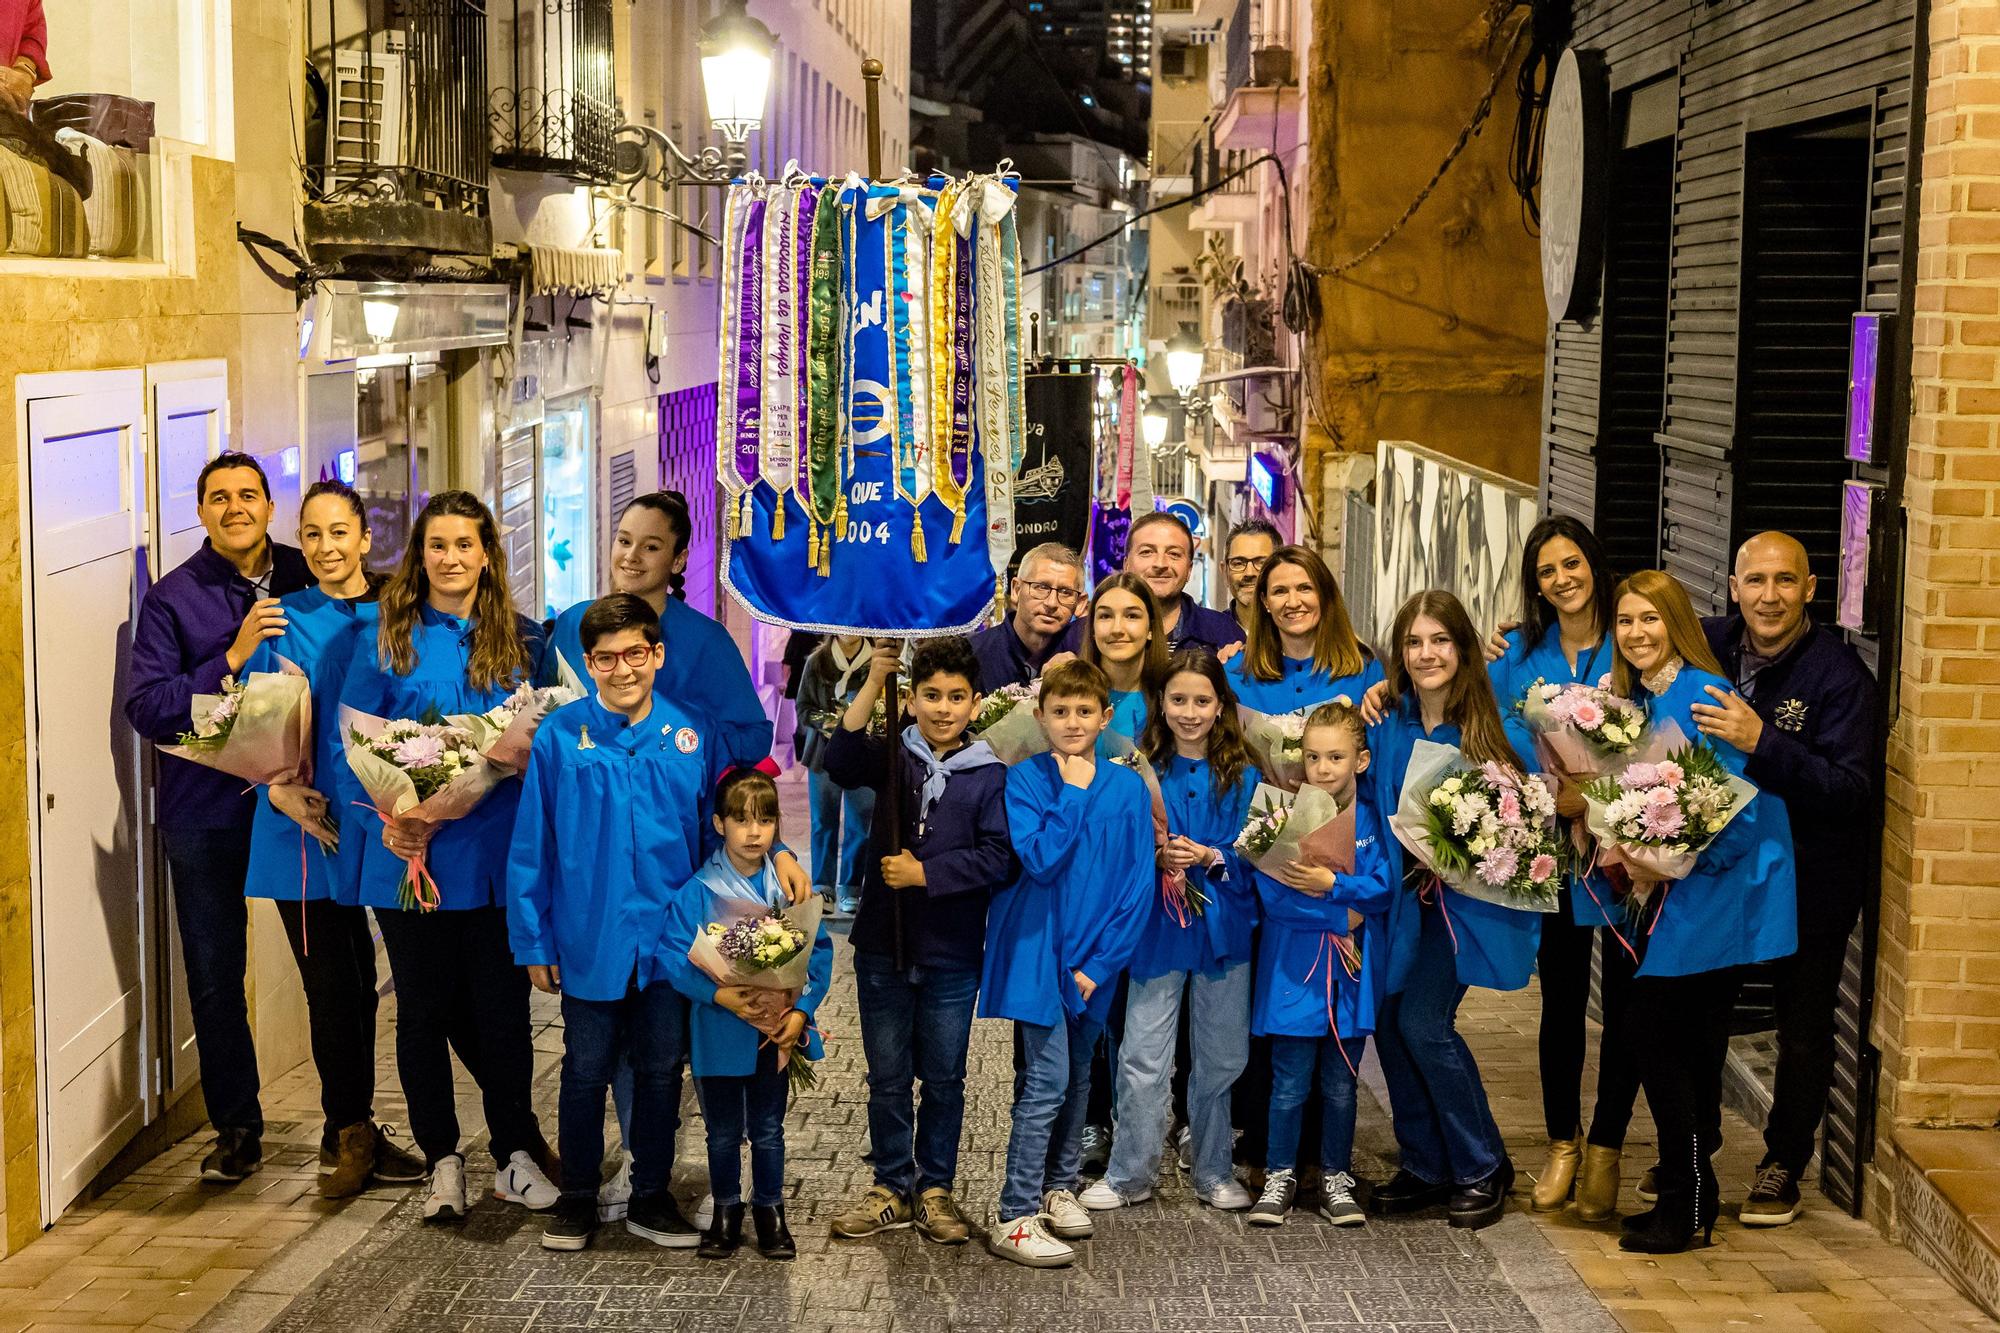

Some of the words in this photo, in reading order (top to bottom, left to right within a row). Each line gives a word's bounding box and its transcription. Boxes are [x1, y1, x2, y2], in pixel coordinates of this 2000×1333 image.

[815, 268, 829, 279] 199
[957, 315, 969, 329] de
[955, 333, 970, 371] Penyes
[956, 376, 968, 406] 2017
[770, 404, 791, 414] SEMPR
[851, 481, 884, 504] QUE
[991, 471, 1007, 501] 94
[836, 521, 890, 545] 004
[1015, 520, 1058, 534] ONDRO
